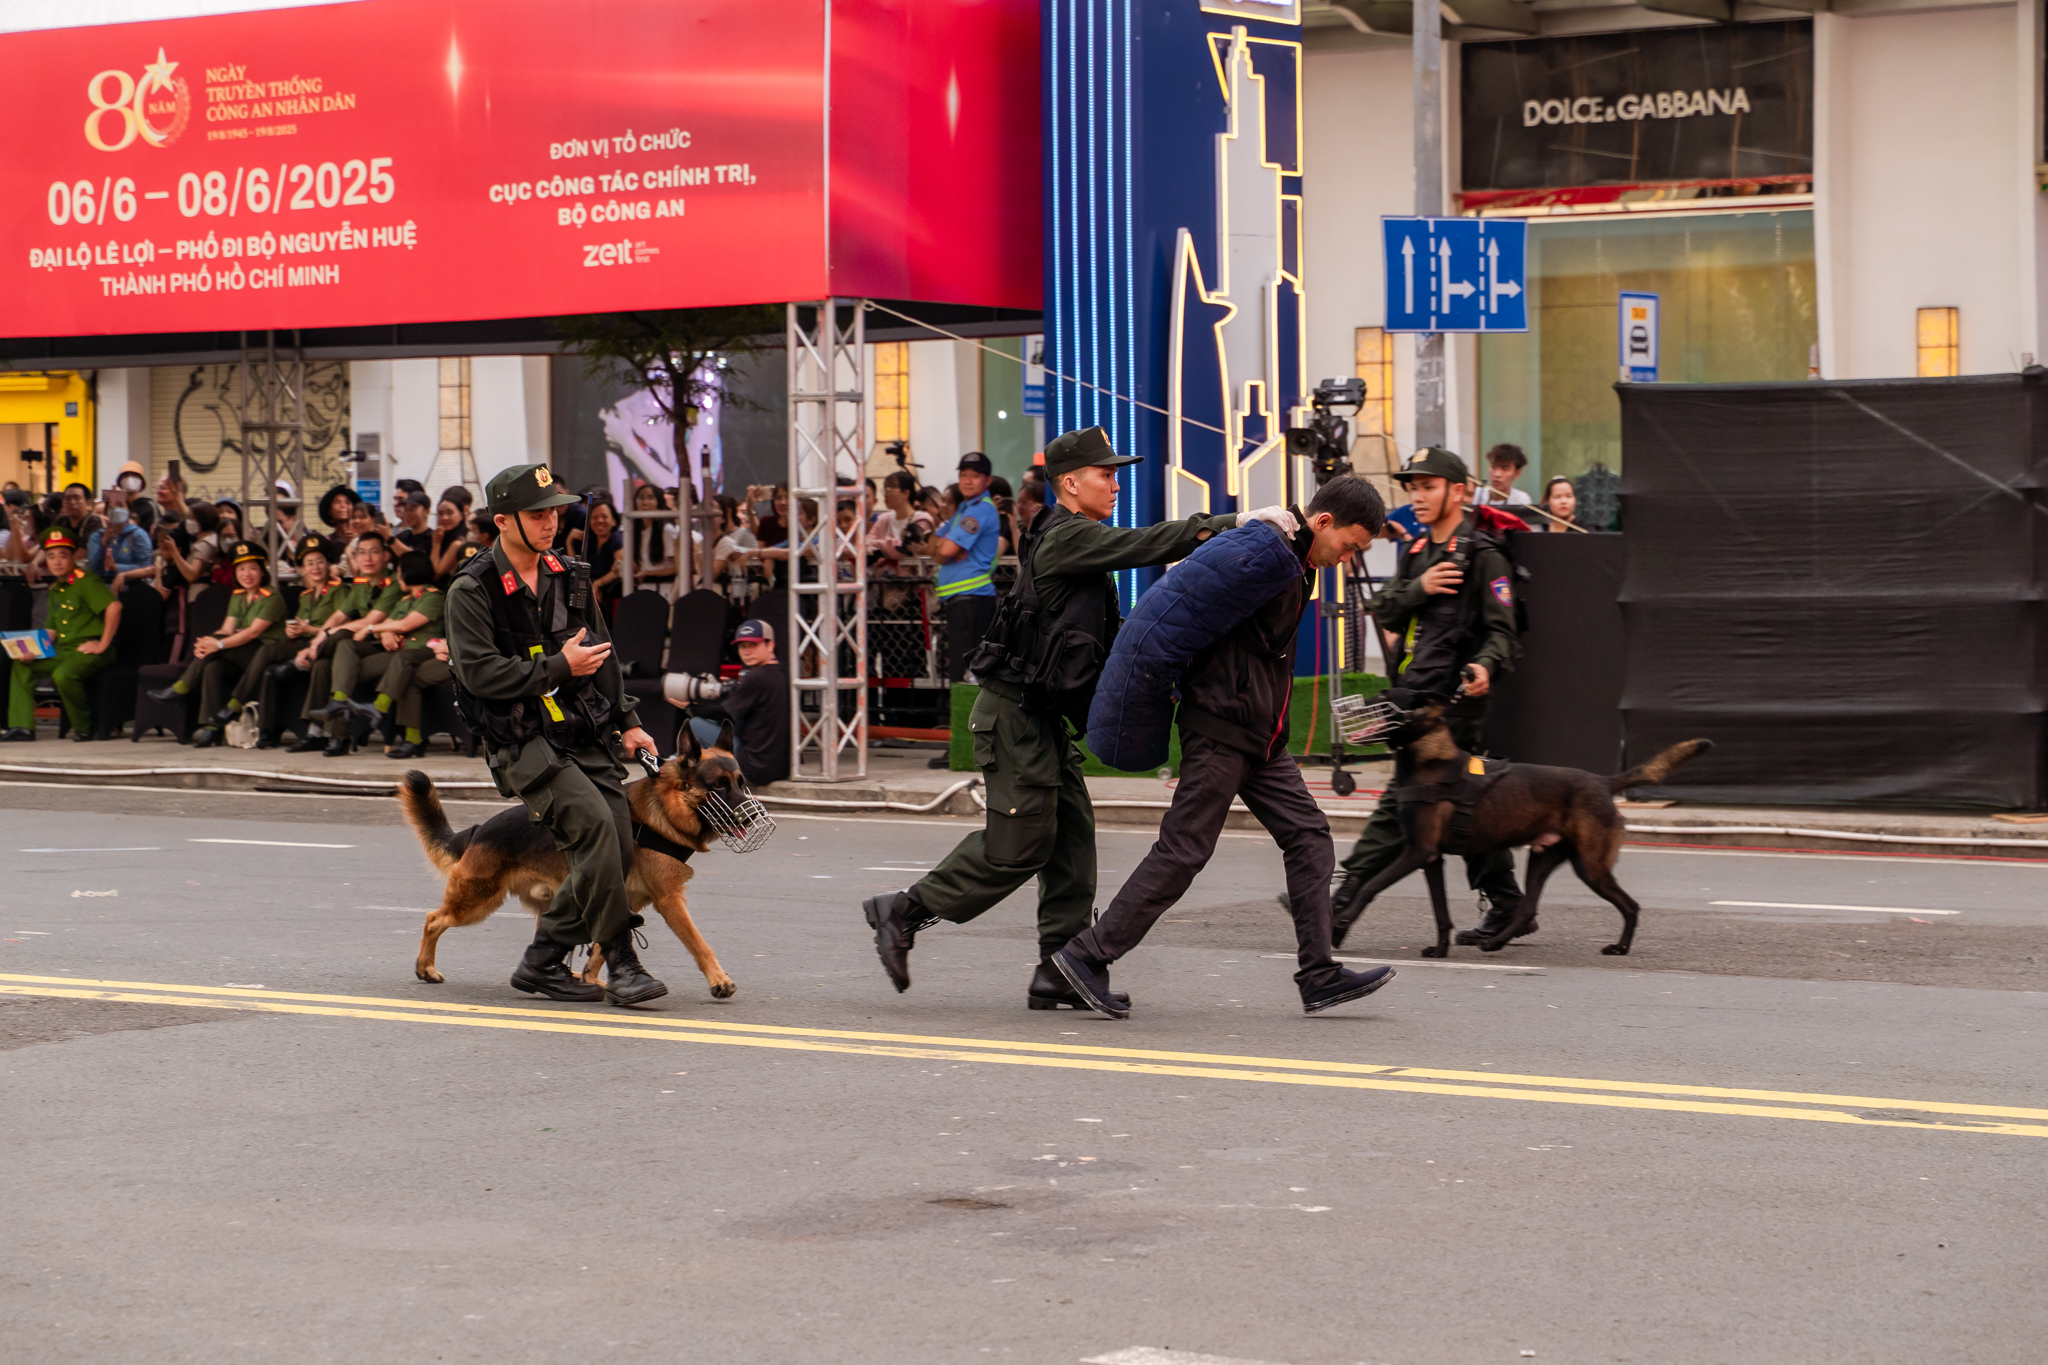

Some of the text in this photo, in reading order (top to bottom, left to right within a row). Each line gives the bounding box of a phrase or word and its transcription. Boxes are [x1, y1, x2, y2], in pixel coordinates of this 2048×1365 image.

[205, 74, 322, 102] TRUYỀN THỐNG
[206, 63, 247, 84] NGÀY
[84, 69, 191, 152] 80
[206, 91, 356, 121] CÔNG AN NHÂN DÂN
[549, 127, 692, 160] ĐƠN VỊ TỔ CHỨC
[47, 176, 138, 226] 06/6
[177, 156, 396, 218] 08/6/2025
[489, 163, 757, 206] CỤC CÔNG TÁC CHÍNH TRỊ,
[558, 198, 685, 229] BỘ CÔNG AN
[29, 247, 63, 272] ĐẠI
[65, 241, 92, 271] LỘ
[95, 240, 120, 266] LÊ
[122, 239, 155, 267] LỢI
[176, 230, 219, 261] PHỐ
[221, 237, 243, 258] ĐI
[246, 230, 277, 261] BỘ
[279, 220, 369, 255] NGUYỄN
[372, 219, 418, 250] HUỆ
[582, 238, 633, 268] zeit
[99, 261, 340, 297] THÀNH PHỐ HỒ CHÍ MINH
